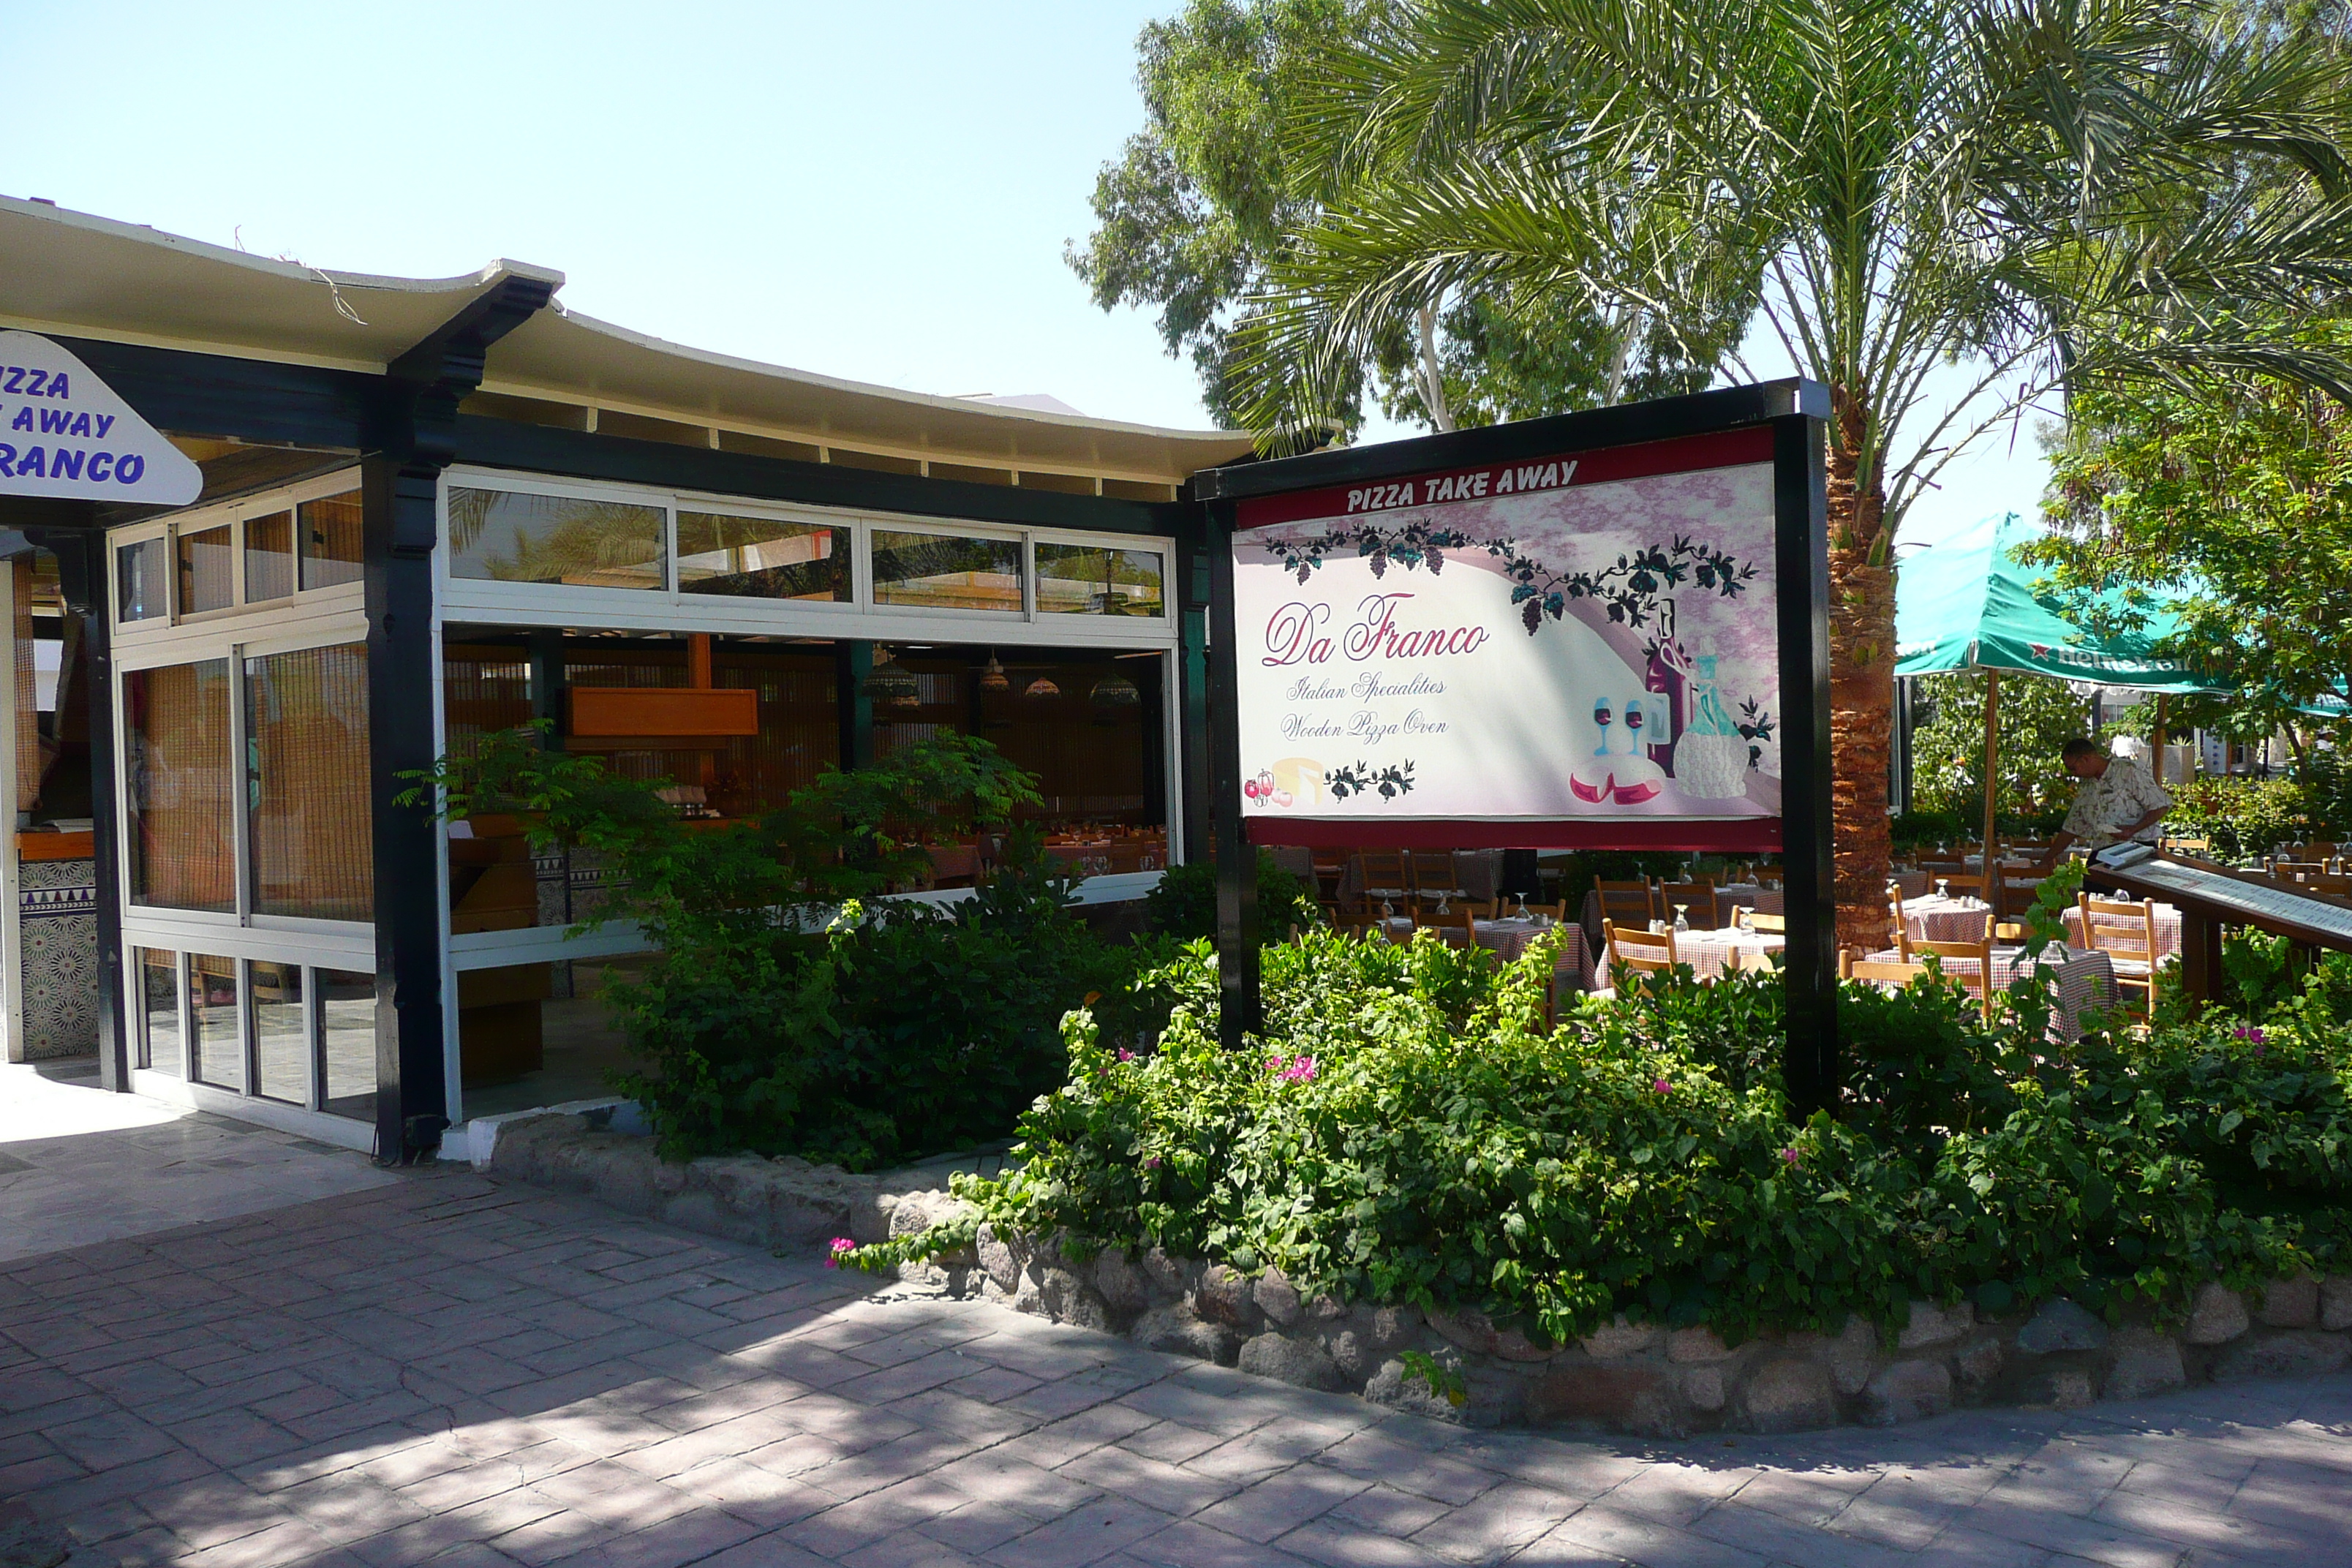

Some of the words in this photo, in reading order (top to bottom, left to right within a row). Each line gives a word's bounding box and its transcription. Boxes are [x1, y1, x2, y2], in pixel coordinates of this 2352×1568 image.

[12, 406, 116, 439] AWAY
[1347, 482, 1414, 513] PIZZA
[1425, 472, 1490, 502] TAKE
[1496, 460, 1578, 493] AWAY
[1262, 602, 1336, 667] Da
[1343, 592, 1490, 662] Franco
[1286, 675, 1347, 701] Italian
[1280, 712, 1344, 742] Wooden
[1346, 709, 1400, 745] Pizza
[1403, 708, 1450, 735] Oven
